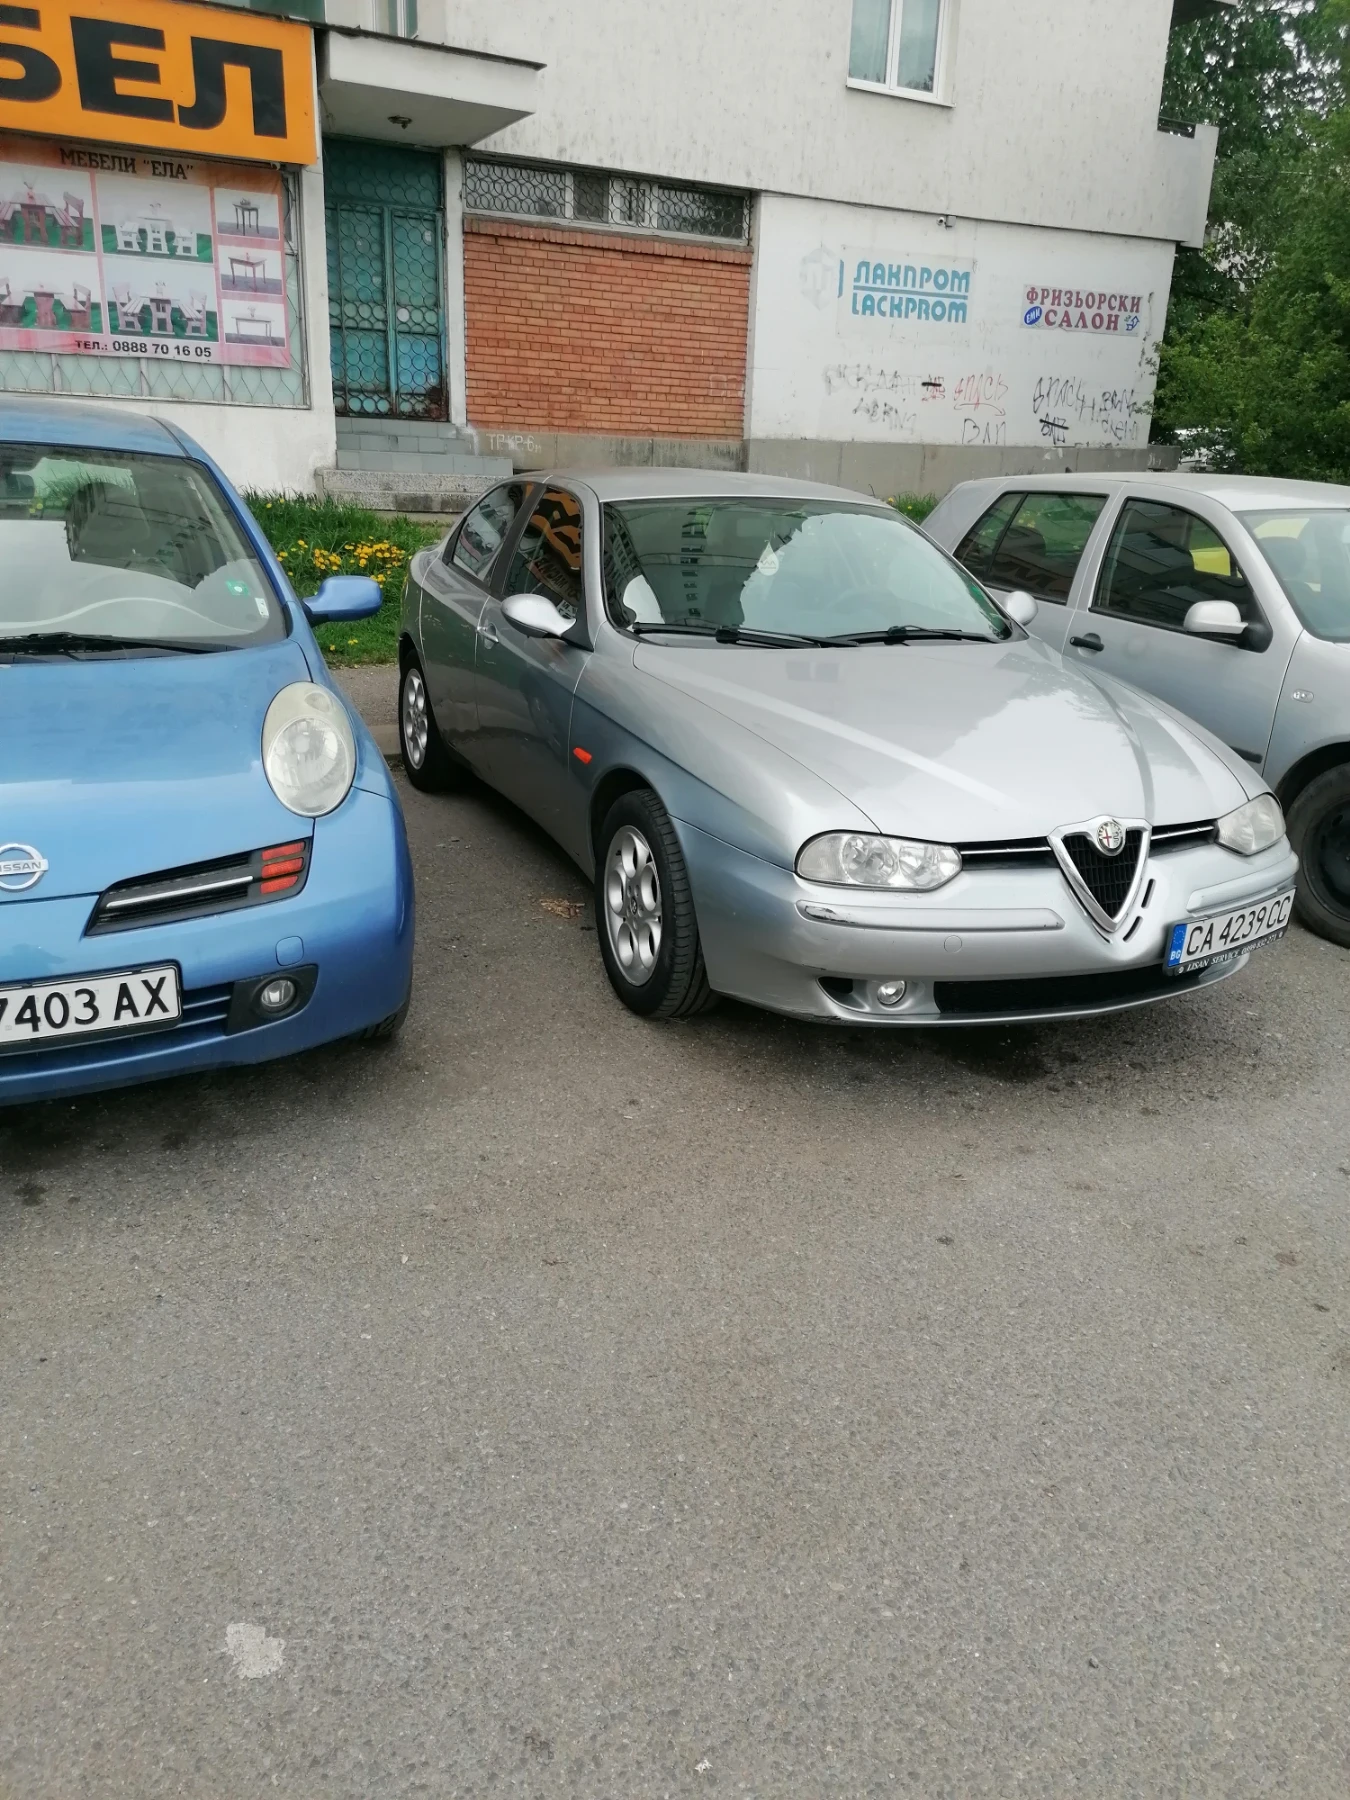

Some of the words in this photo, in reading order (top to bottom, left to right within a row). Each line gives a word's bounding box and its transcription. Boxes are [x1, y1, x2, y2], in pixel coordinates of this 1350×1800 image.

[0, 5, 288, 139] БЕЛ
[59, 147, 137, 174] МЕБЕЛИ
[853, 260, 971, 293] ЛАКПРОМ
[852, 292, 968, 324] LACKPROM
[1026, 286, 1143, 313] ФРИЗЬОРСКИ
[1044, 309, 1120, 331] САЛОН
[112, 340, 148, 353] 0888
[152, 343, 169, 354] 70
[174, 345, 191, 356] 16
[195, 346, 212, 357] 05
[1186, 922, 1214, 956] CA
[1218, 906, 1267, 946] 4239
[1266, 895, 1291, 929] CC
[1170, 950, 1182, 961] BG
[1211, 949, 1239, 965] SERVICE
[113, 976, 170, 1022] AX
